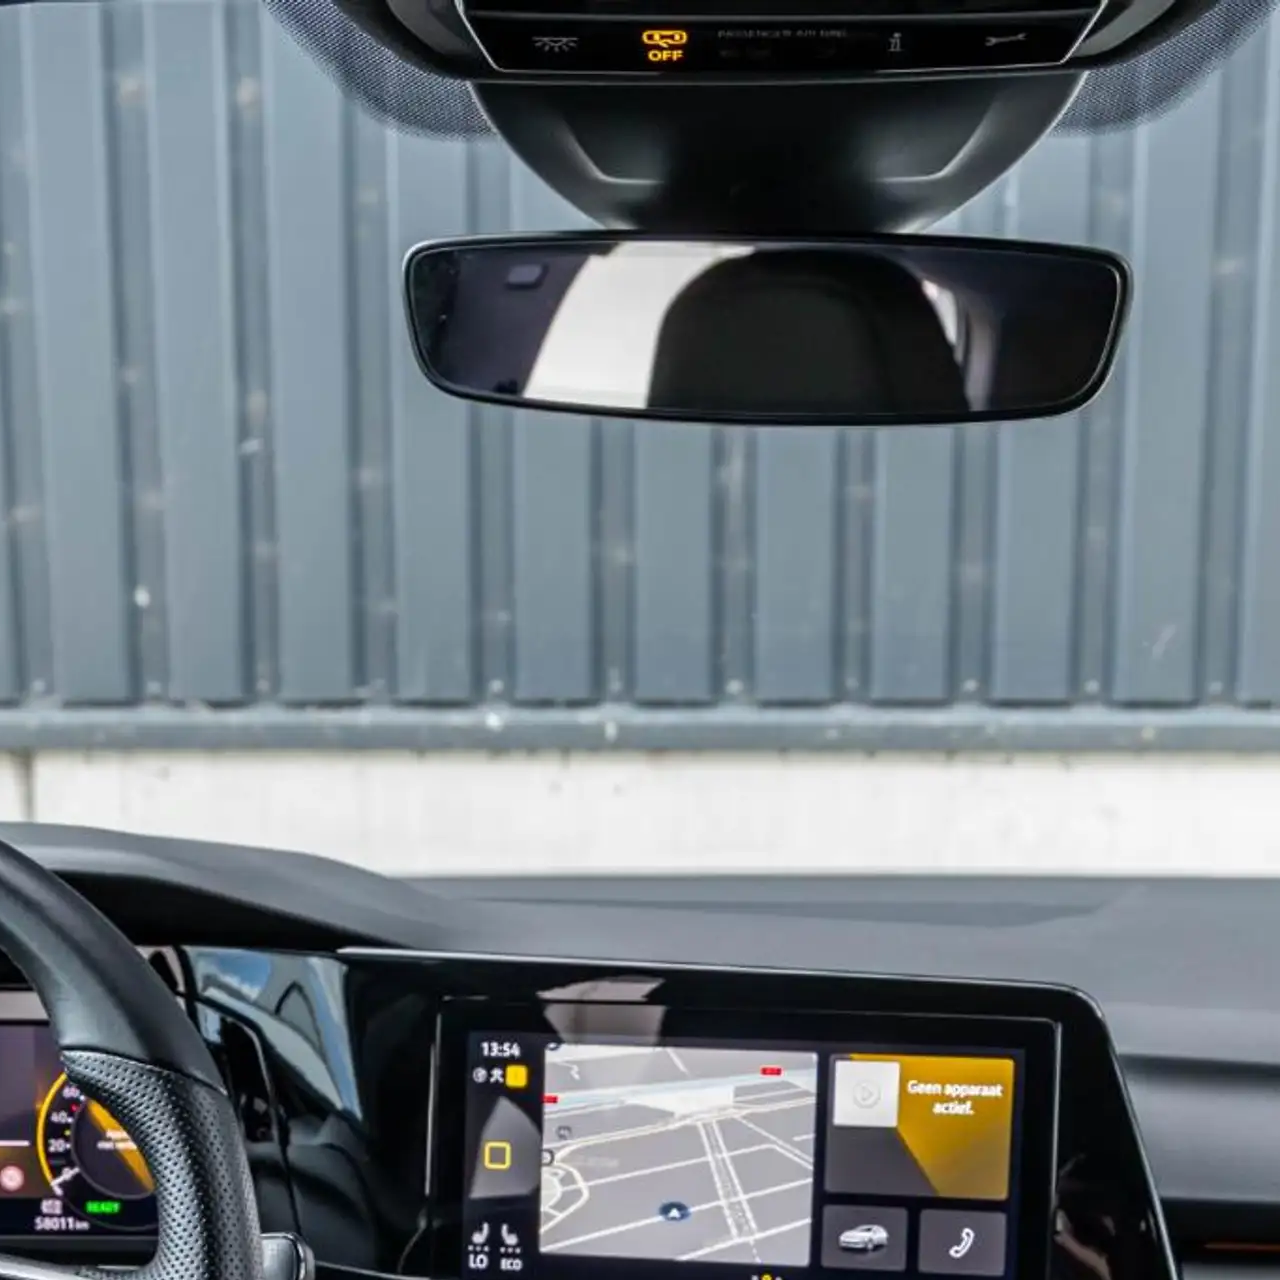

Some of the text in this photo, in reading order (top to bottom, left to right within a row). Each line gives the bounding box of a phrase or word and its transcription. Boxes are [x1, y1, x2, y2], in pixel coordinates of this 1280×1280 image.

[648, 50, 683, 61] OFF
[481, 1042, 520, 1057] 13:54
[908, 1081, 1003, 1098] Geen apparaat
[932, 1101, 975, 1115] actief.
[48, 1139, 66, 1152] 20
[469, 1254, 488, 1269] LO
[500, 1258, 522, 1271] ECO
